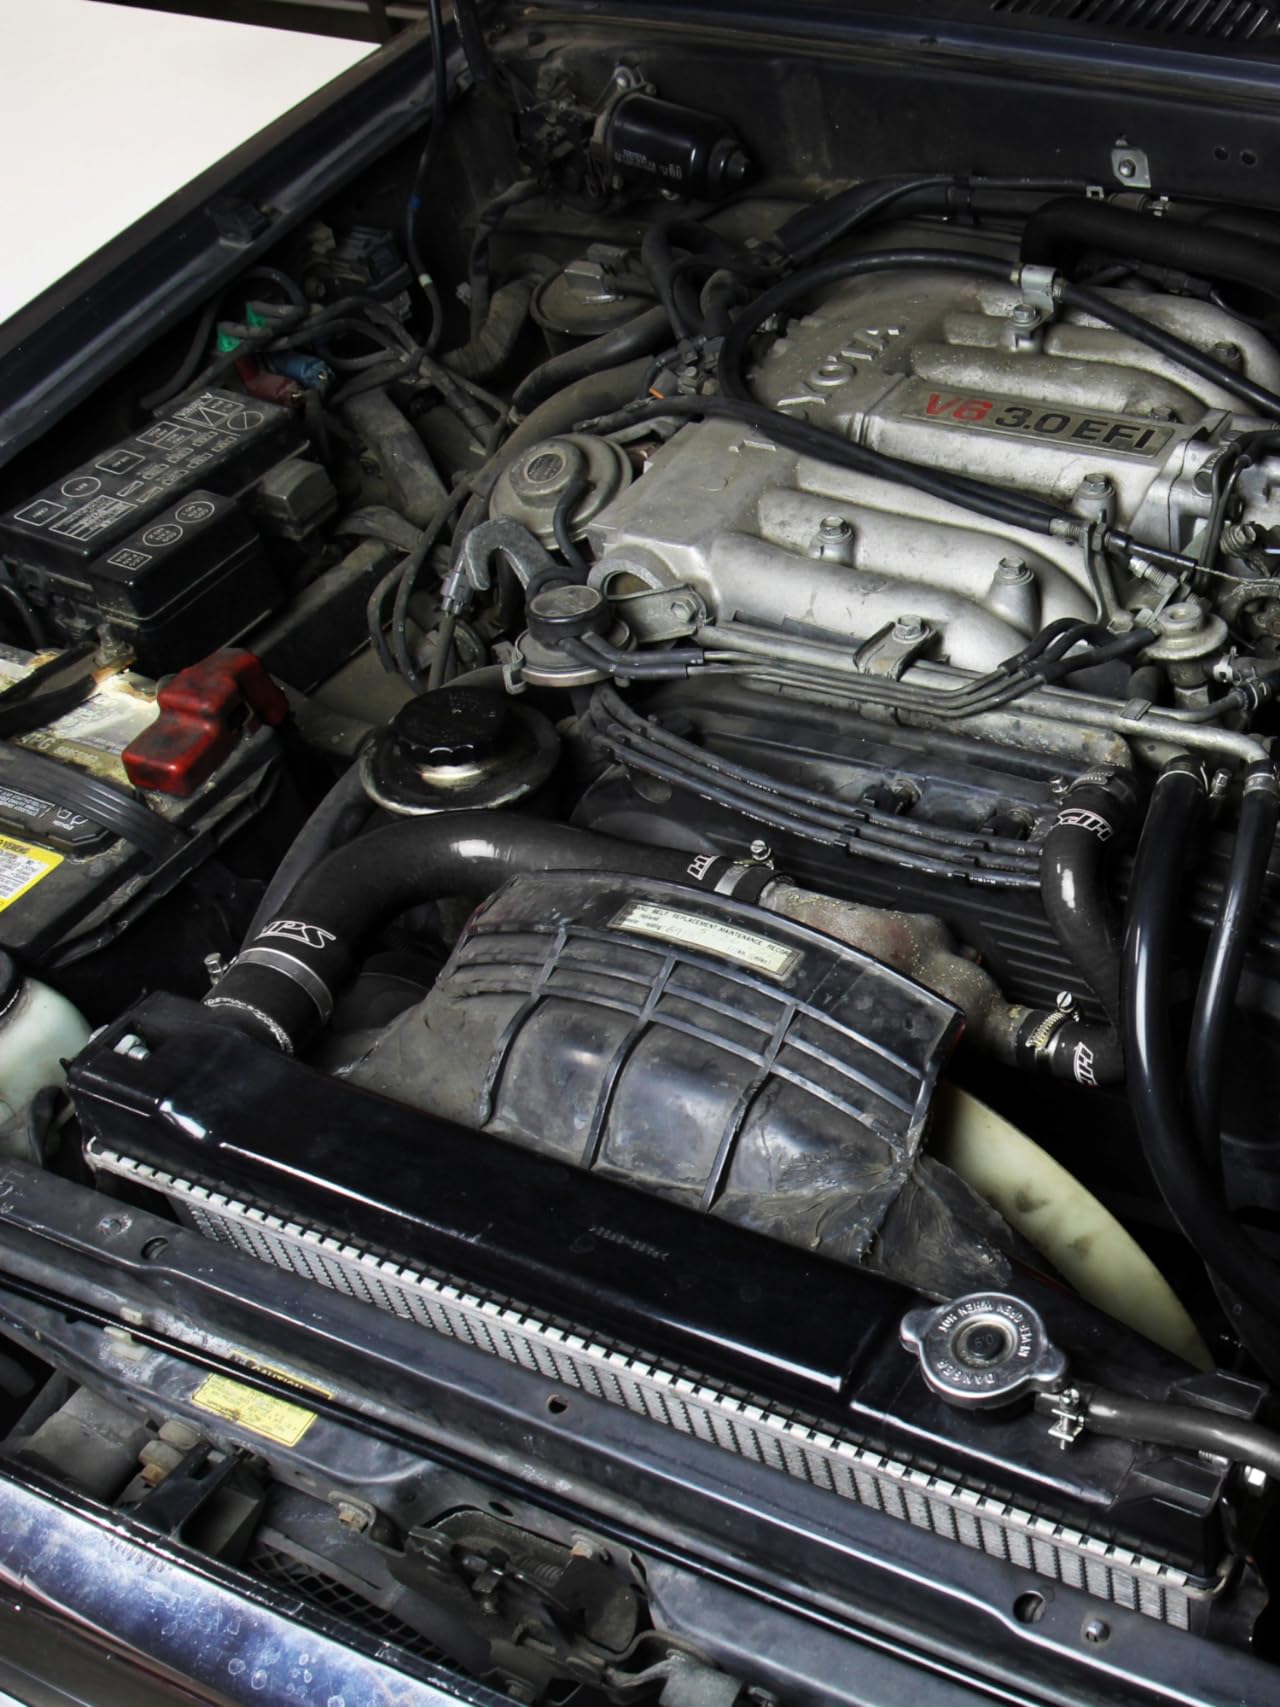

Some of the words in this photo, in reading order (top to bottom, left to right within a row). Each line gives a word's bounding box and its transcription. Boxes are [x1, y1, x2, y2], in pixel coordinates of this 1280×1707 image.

[925, 392, 993, 422] V6
[995, 406, 1071, 434] 3.0
[1071, 419, 1156, 449] EFI
[672, 913, 719, 929] REPLACEMENT
[719, 926, 763, 946] MAINTENANCE
[936, 1361, 996, 1385] DANGER
